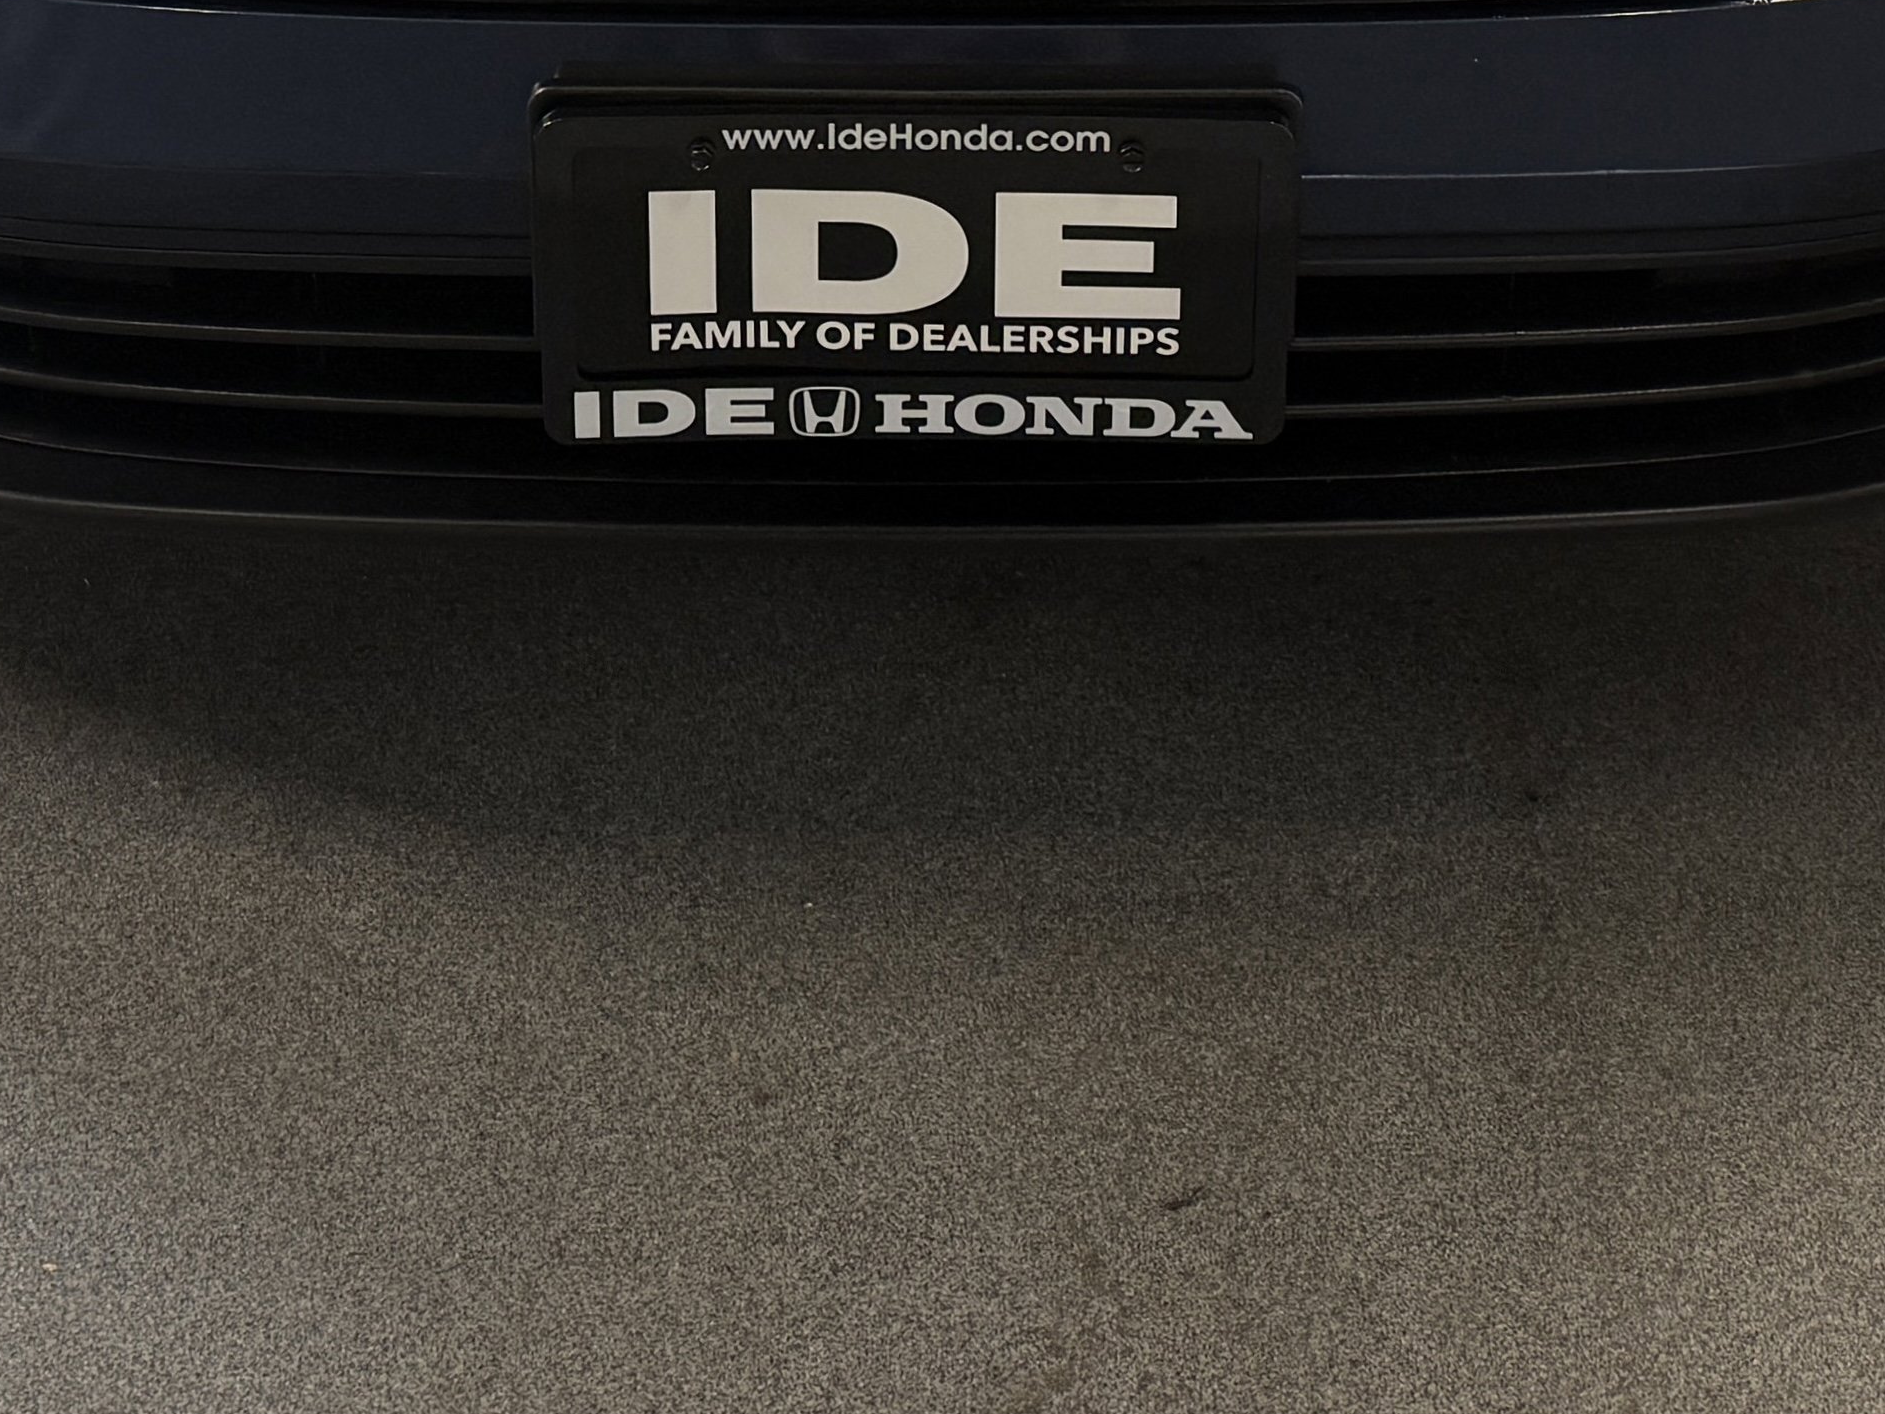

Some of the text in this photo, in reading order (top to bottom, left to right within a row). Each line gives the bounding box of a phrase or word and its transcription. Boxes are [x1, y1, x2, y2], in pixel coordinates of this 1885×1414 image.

[721, 122, 1112, 153] www.IdeHonda.com
[647, 188, 1182, 320] IDE
[650, 320, 1181, 356] FAMILY OF DEALERSHIPS
[573, 386, 776, 439] IDE
[874, 393, 1254, 441] HONDA
